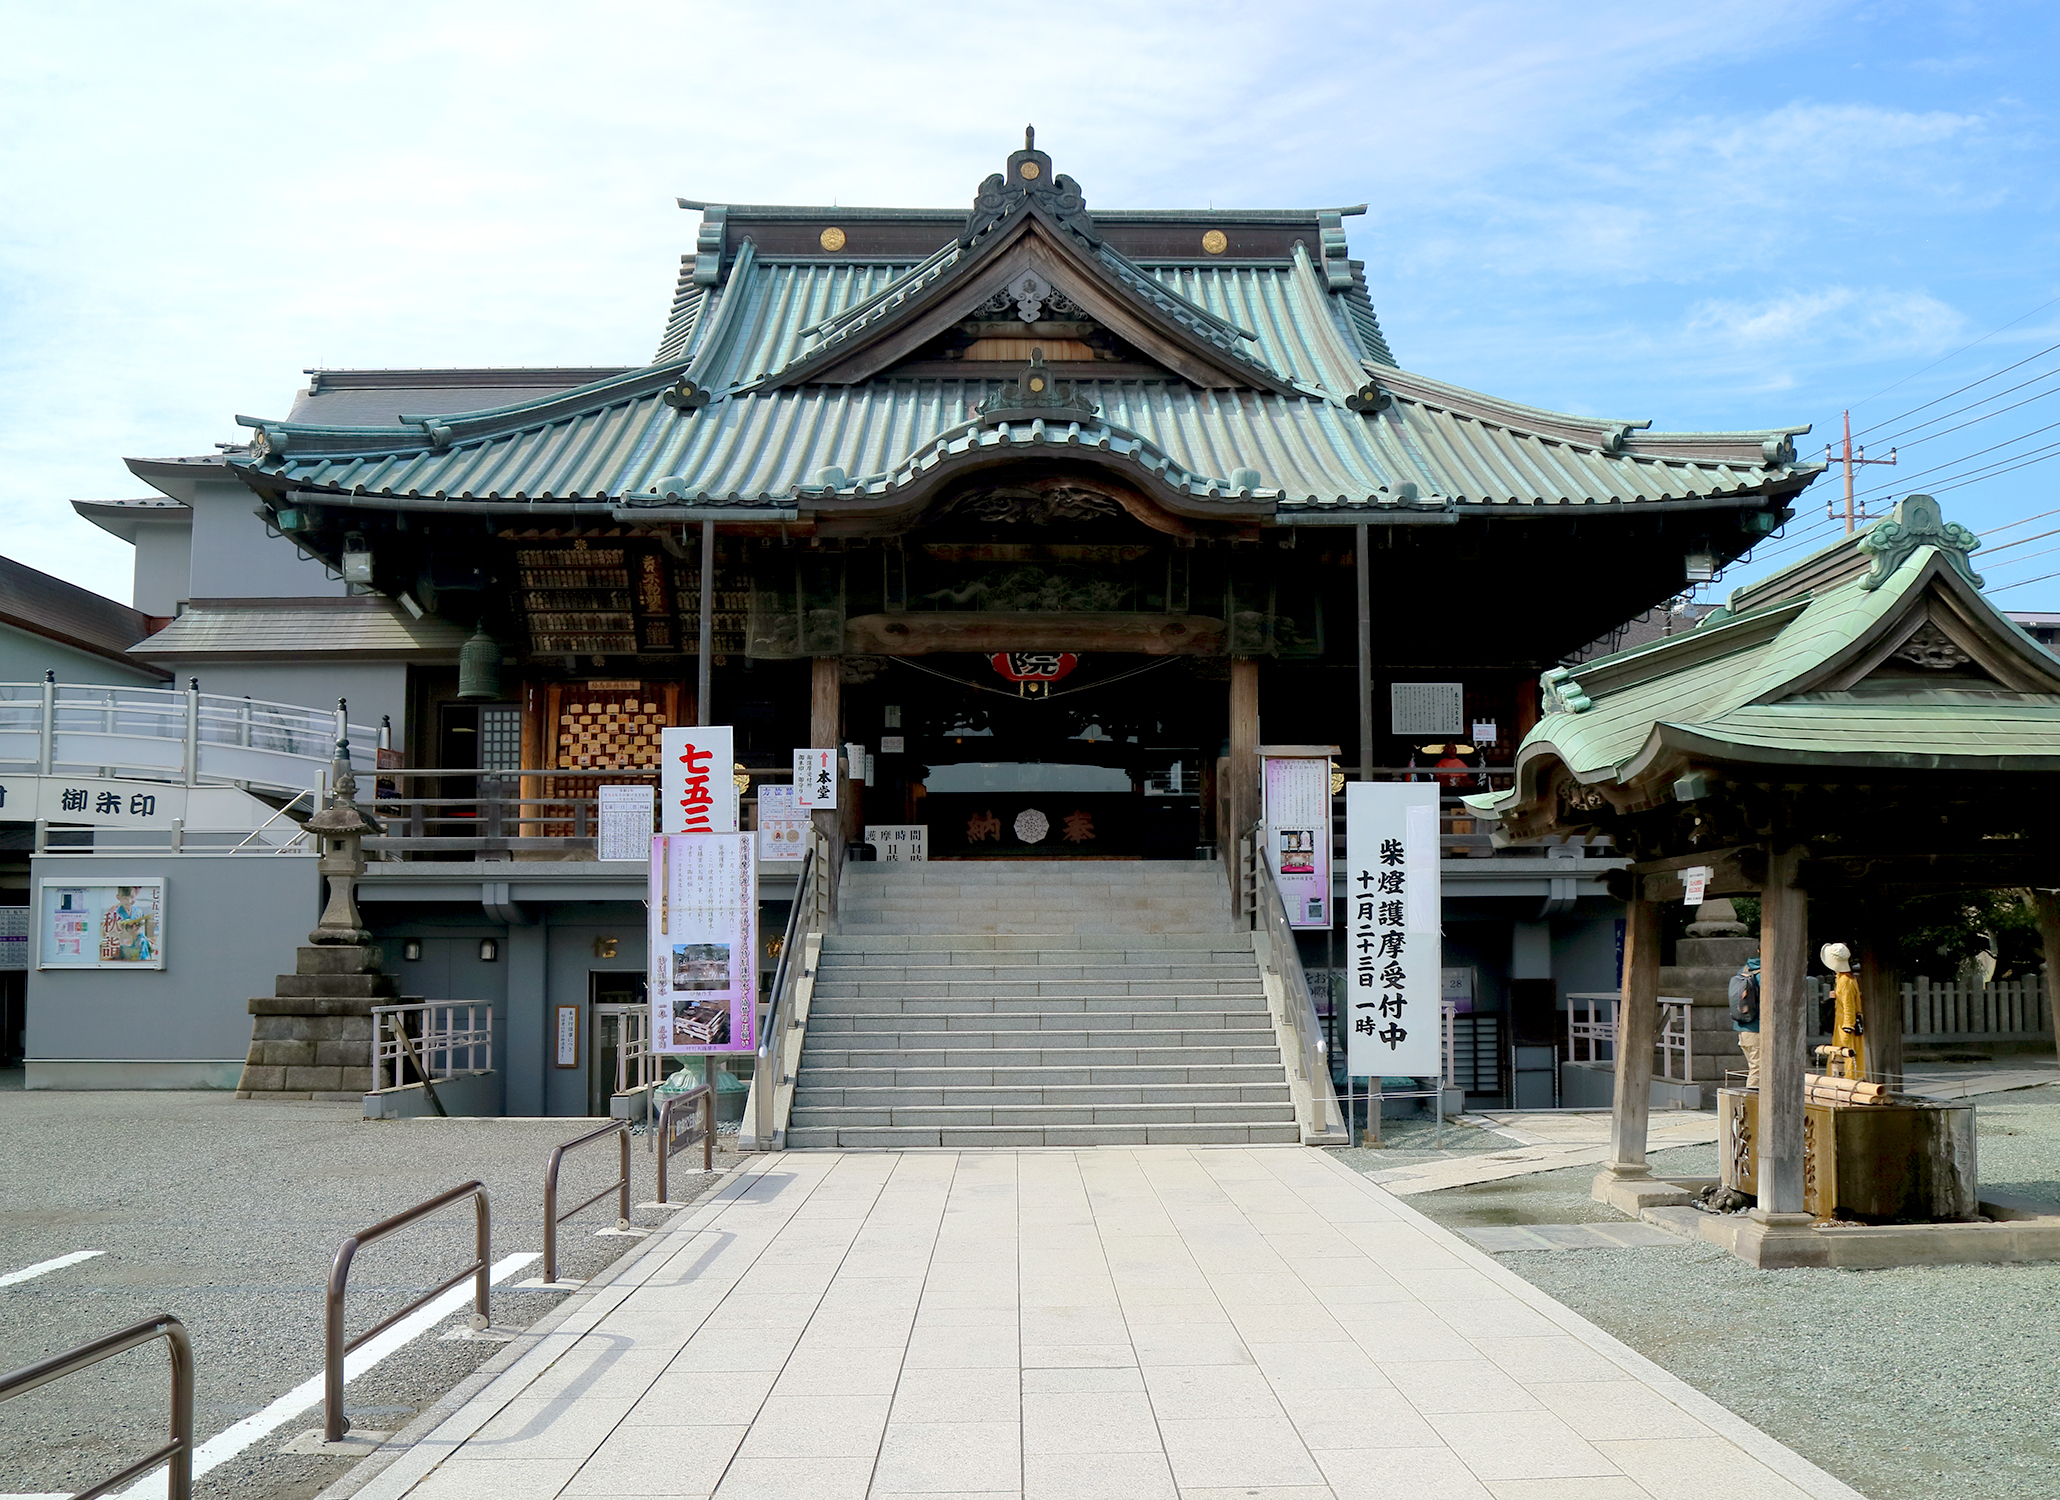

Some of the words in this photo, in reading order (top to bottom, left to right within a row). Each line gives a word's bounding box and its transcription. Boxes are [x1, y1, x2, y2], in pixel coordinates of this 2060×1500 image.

[679, 743, 714, 832] 七五三
[816, 769, 832, 799] 本堂
[61, 788, 156, 817] 御朱印
[865, 830, 921, 841] 護摩時間
[888, 844, 897, 854] 11
[911, 844, 921, 854] 14
[103, 912, 122, 958] 秋詣
[1356, 870, 1375, 988] 十一月二十三日
[1377, 838, 1408, 1051] 柴燈護摩受付中
[1450, 979, 1462, 988] 28
[1355, 1002, 1376, 1036] 一時
